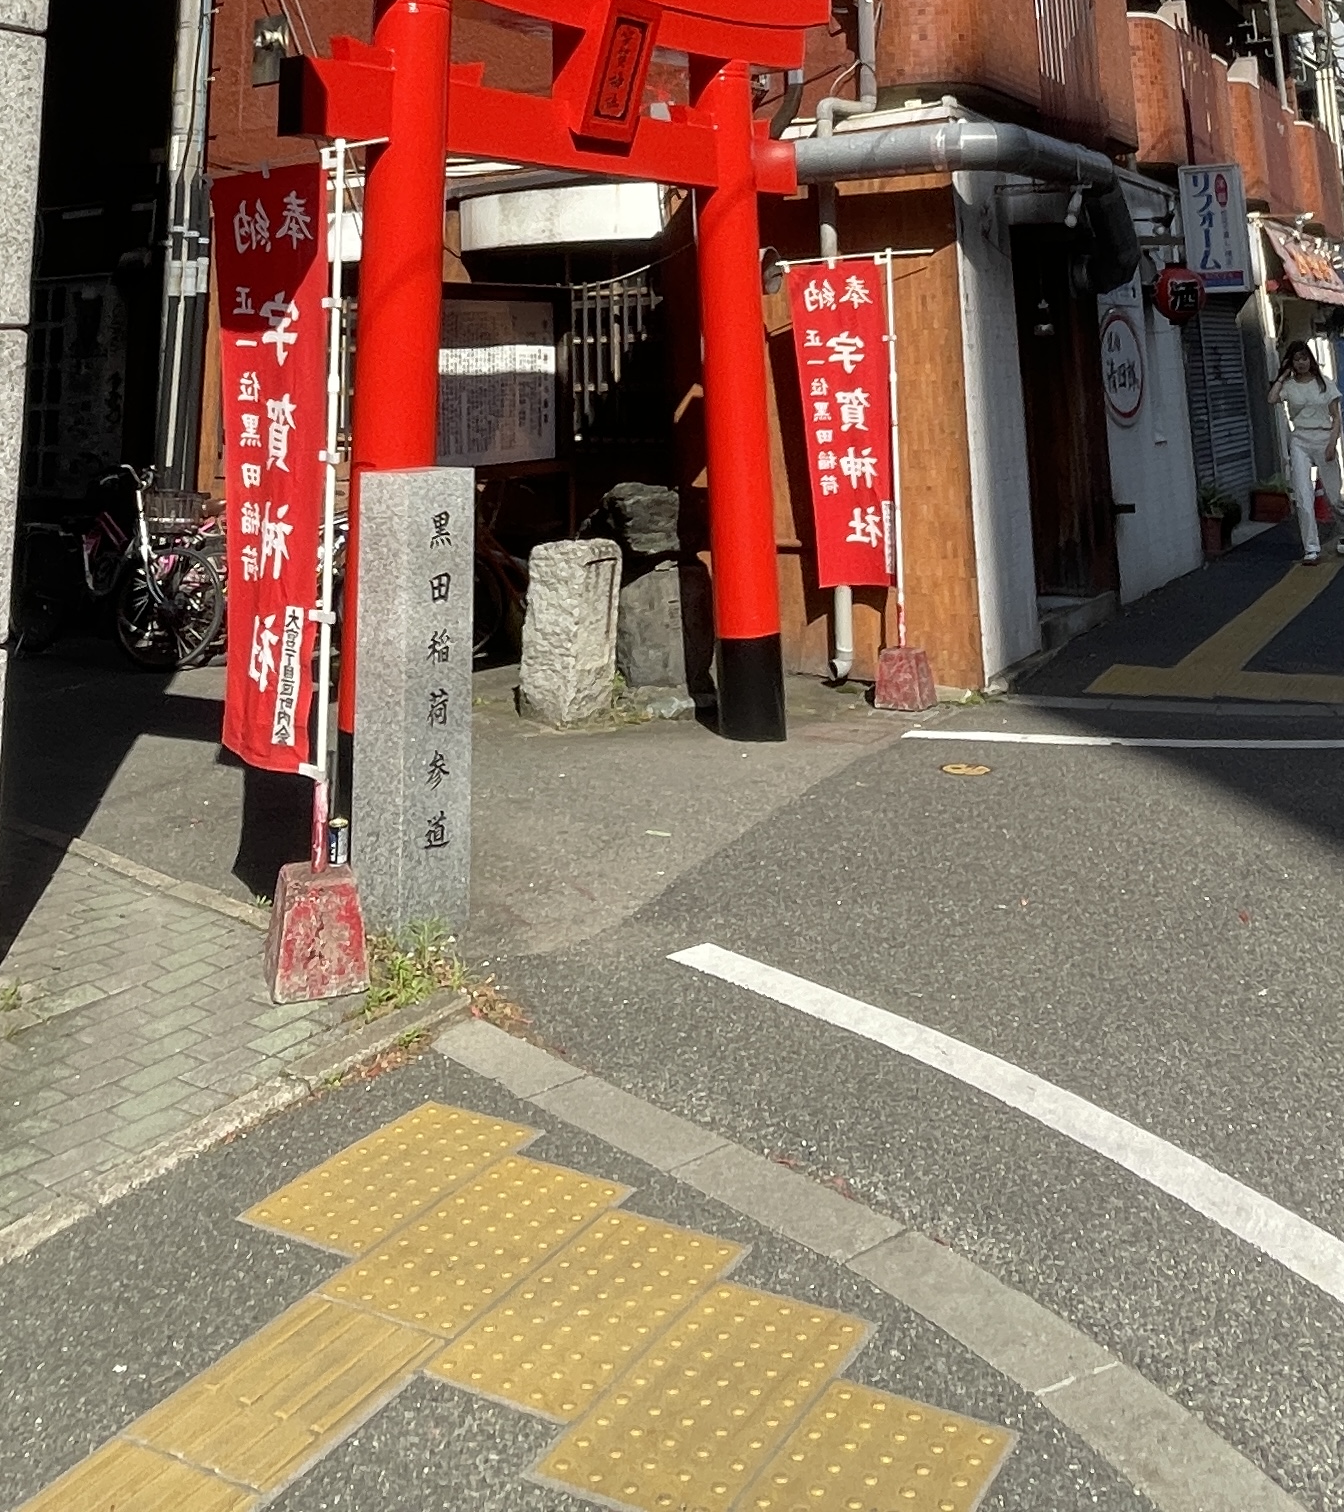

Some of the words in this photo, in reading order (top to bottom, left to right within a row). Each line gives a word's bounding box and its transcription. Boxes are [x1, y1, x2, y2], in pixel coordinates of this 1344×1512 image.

[1168, 279, 1199, 312] 酒
[424, 510, 453, 850] 黒田稲荷参道
